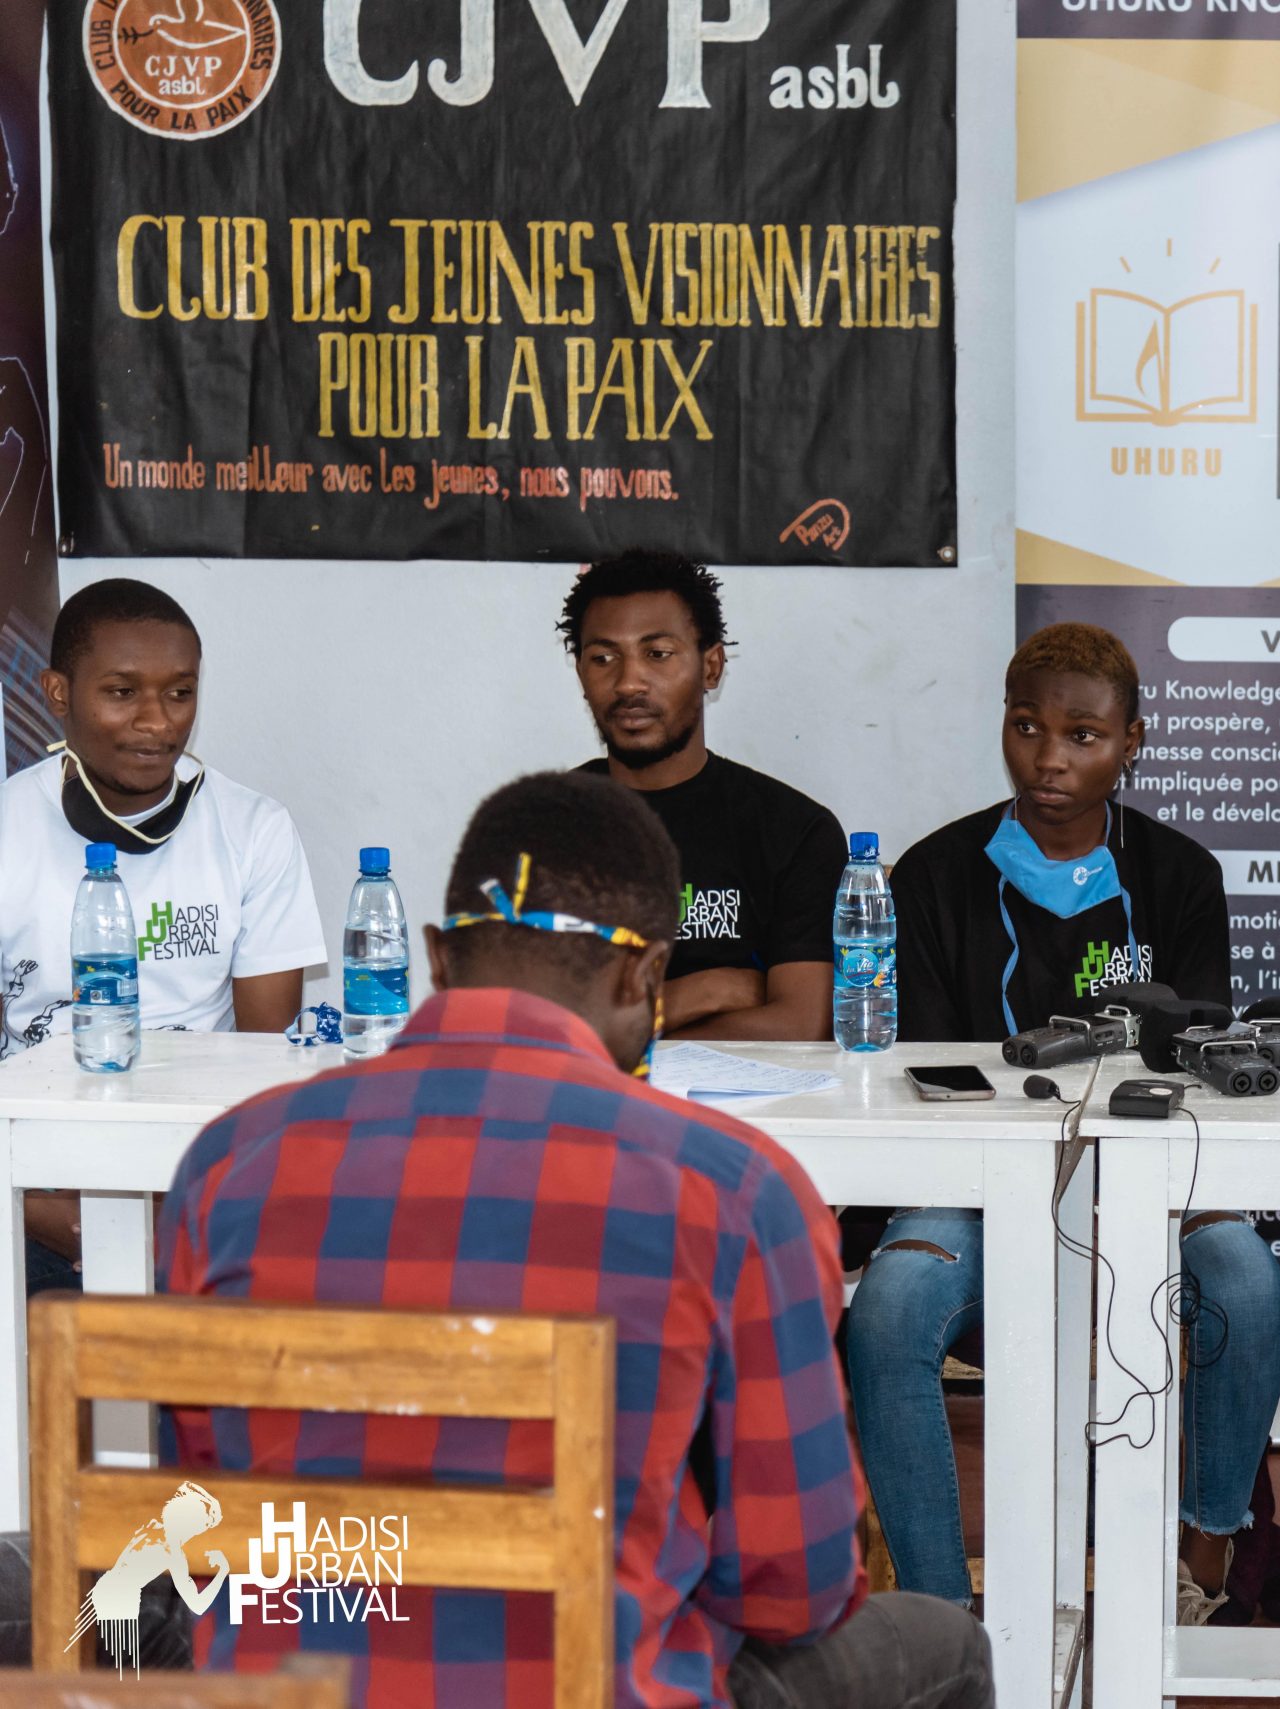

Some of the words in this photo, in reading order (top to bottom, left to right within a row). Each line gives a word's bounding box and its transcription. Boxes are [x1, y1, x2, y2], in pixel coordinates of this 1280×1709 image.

[144, 54, 222, 77] CJVP
[323, 0, 771, 108] CJVP
[769, 44, 900, 109] asbl
[158, 76, 206, 95] asbl
[111, 79, 160, 124] POUR
[170, 112, 197, 130] LA
[206, 85, 252, 127] PAIX
[117, 215, 270, 321] CLUB
[289, 218, 371, 322] DES
[388, 219, 595, 325] JEUNES
[612, 222, 941, 328] VISIONNAIRES
[318, 332, 440, 438] POUR
[465, 335, 551, 440] LA
[564, 336, 714, 441] PAIX
[1111, 448, 1222, 477] UHURU
[103, 443, 133, 489] Un
[138, 444, 205, 490] monde
[216, 445, 314, 492] meilleur
[322, 464, 371, 492] avec
[424, 459, 510, 509] jeunes,
[520, 466, 570, 498] nous
[580, 467, 679, 511] pouvons.
[1167, 712, 1271, 735] prospère,
[1134, 770, 1243, 796] impliquée
[1157, 804, 1178, 821] et
[1186, 801, 1205, 821] le
[151, 901, 219, 926] HADISI
[679, 899, 738, 923] RBAN
[146, 918, 217, 944] URBAN
[138, 936, 220, 961] FESTIVAL
[1231, 945, 1254, 960] se
[1261, 941, 1275, 960] à
